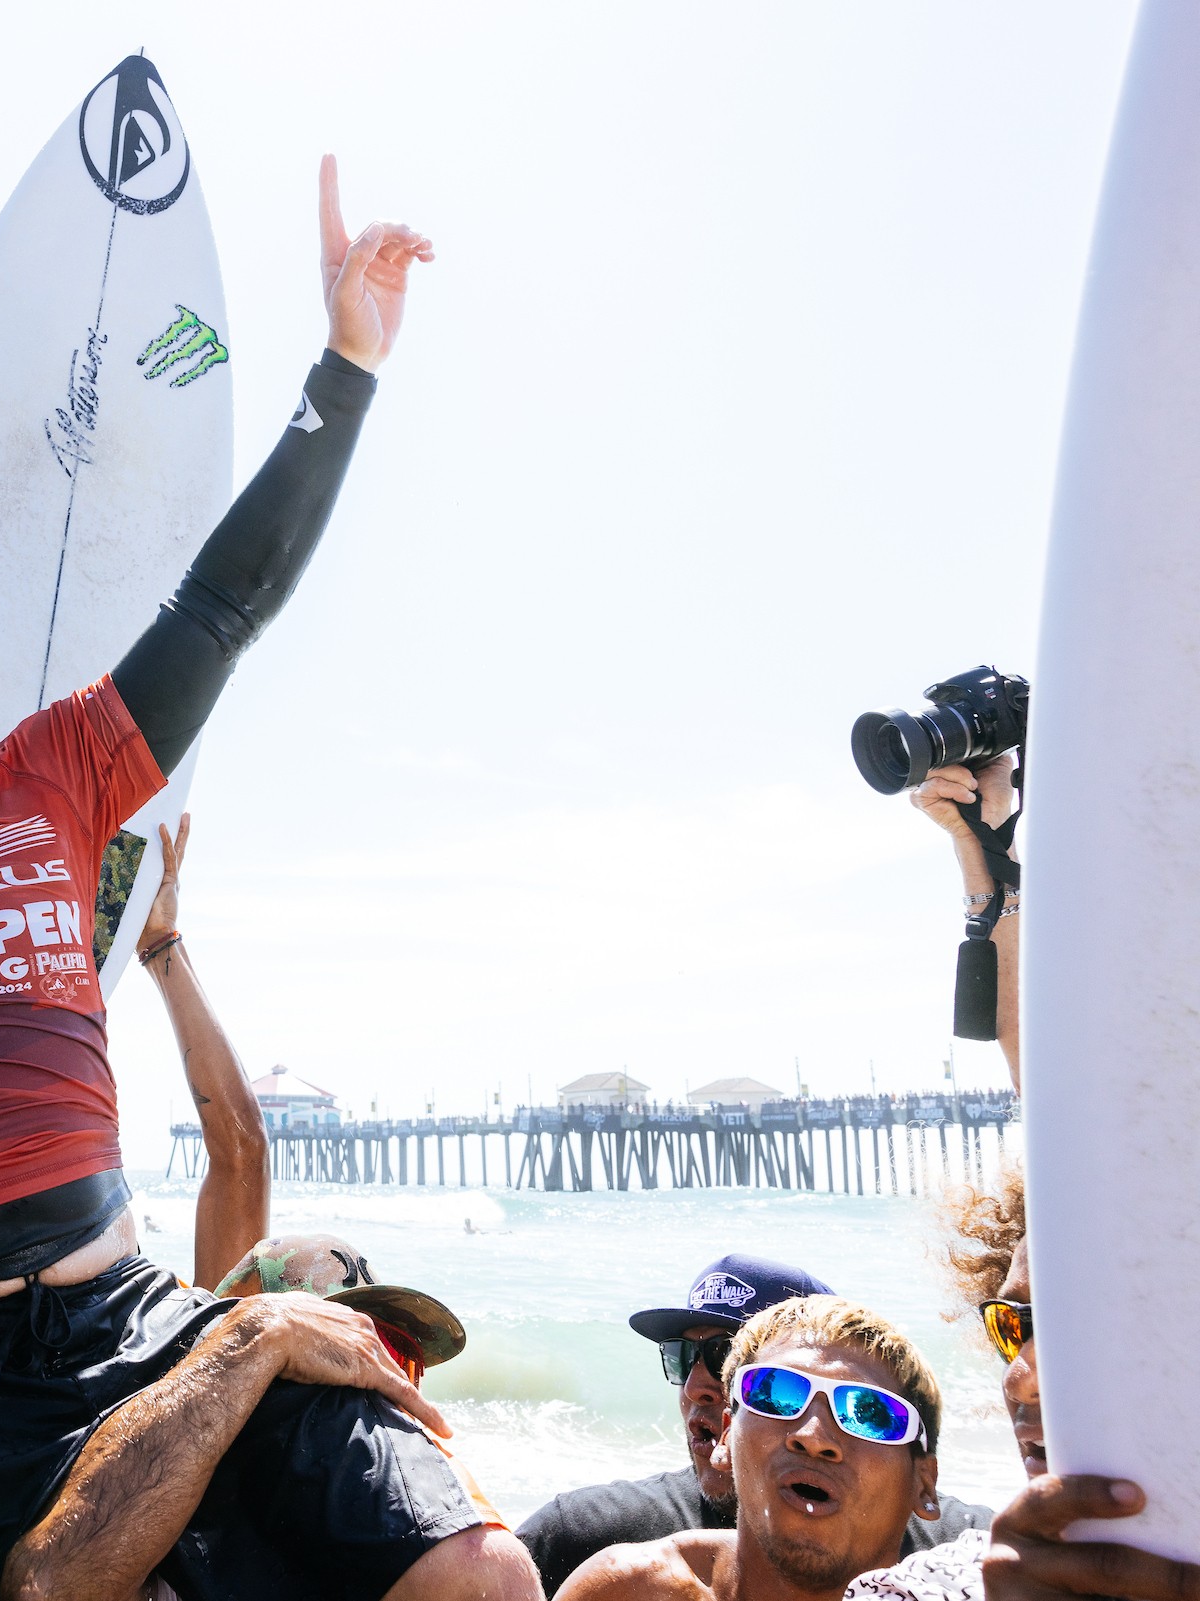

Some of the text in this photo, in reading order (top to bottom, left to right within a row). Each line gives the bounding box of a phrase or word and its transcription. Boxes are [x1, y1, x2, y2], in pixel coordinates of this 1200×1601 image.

[720, 1112, 746, 1125] YETI
[704, 1278, 727, 1288] VANS
[704, 1285, 721, 1300] THE
